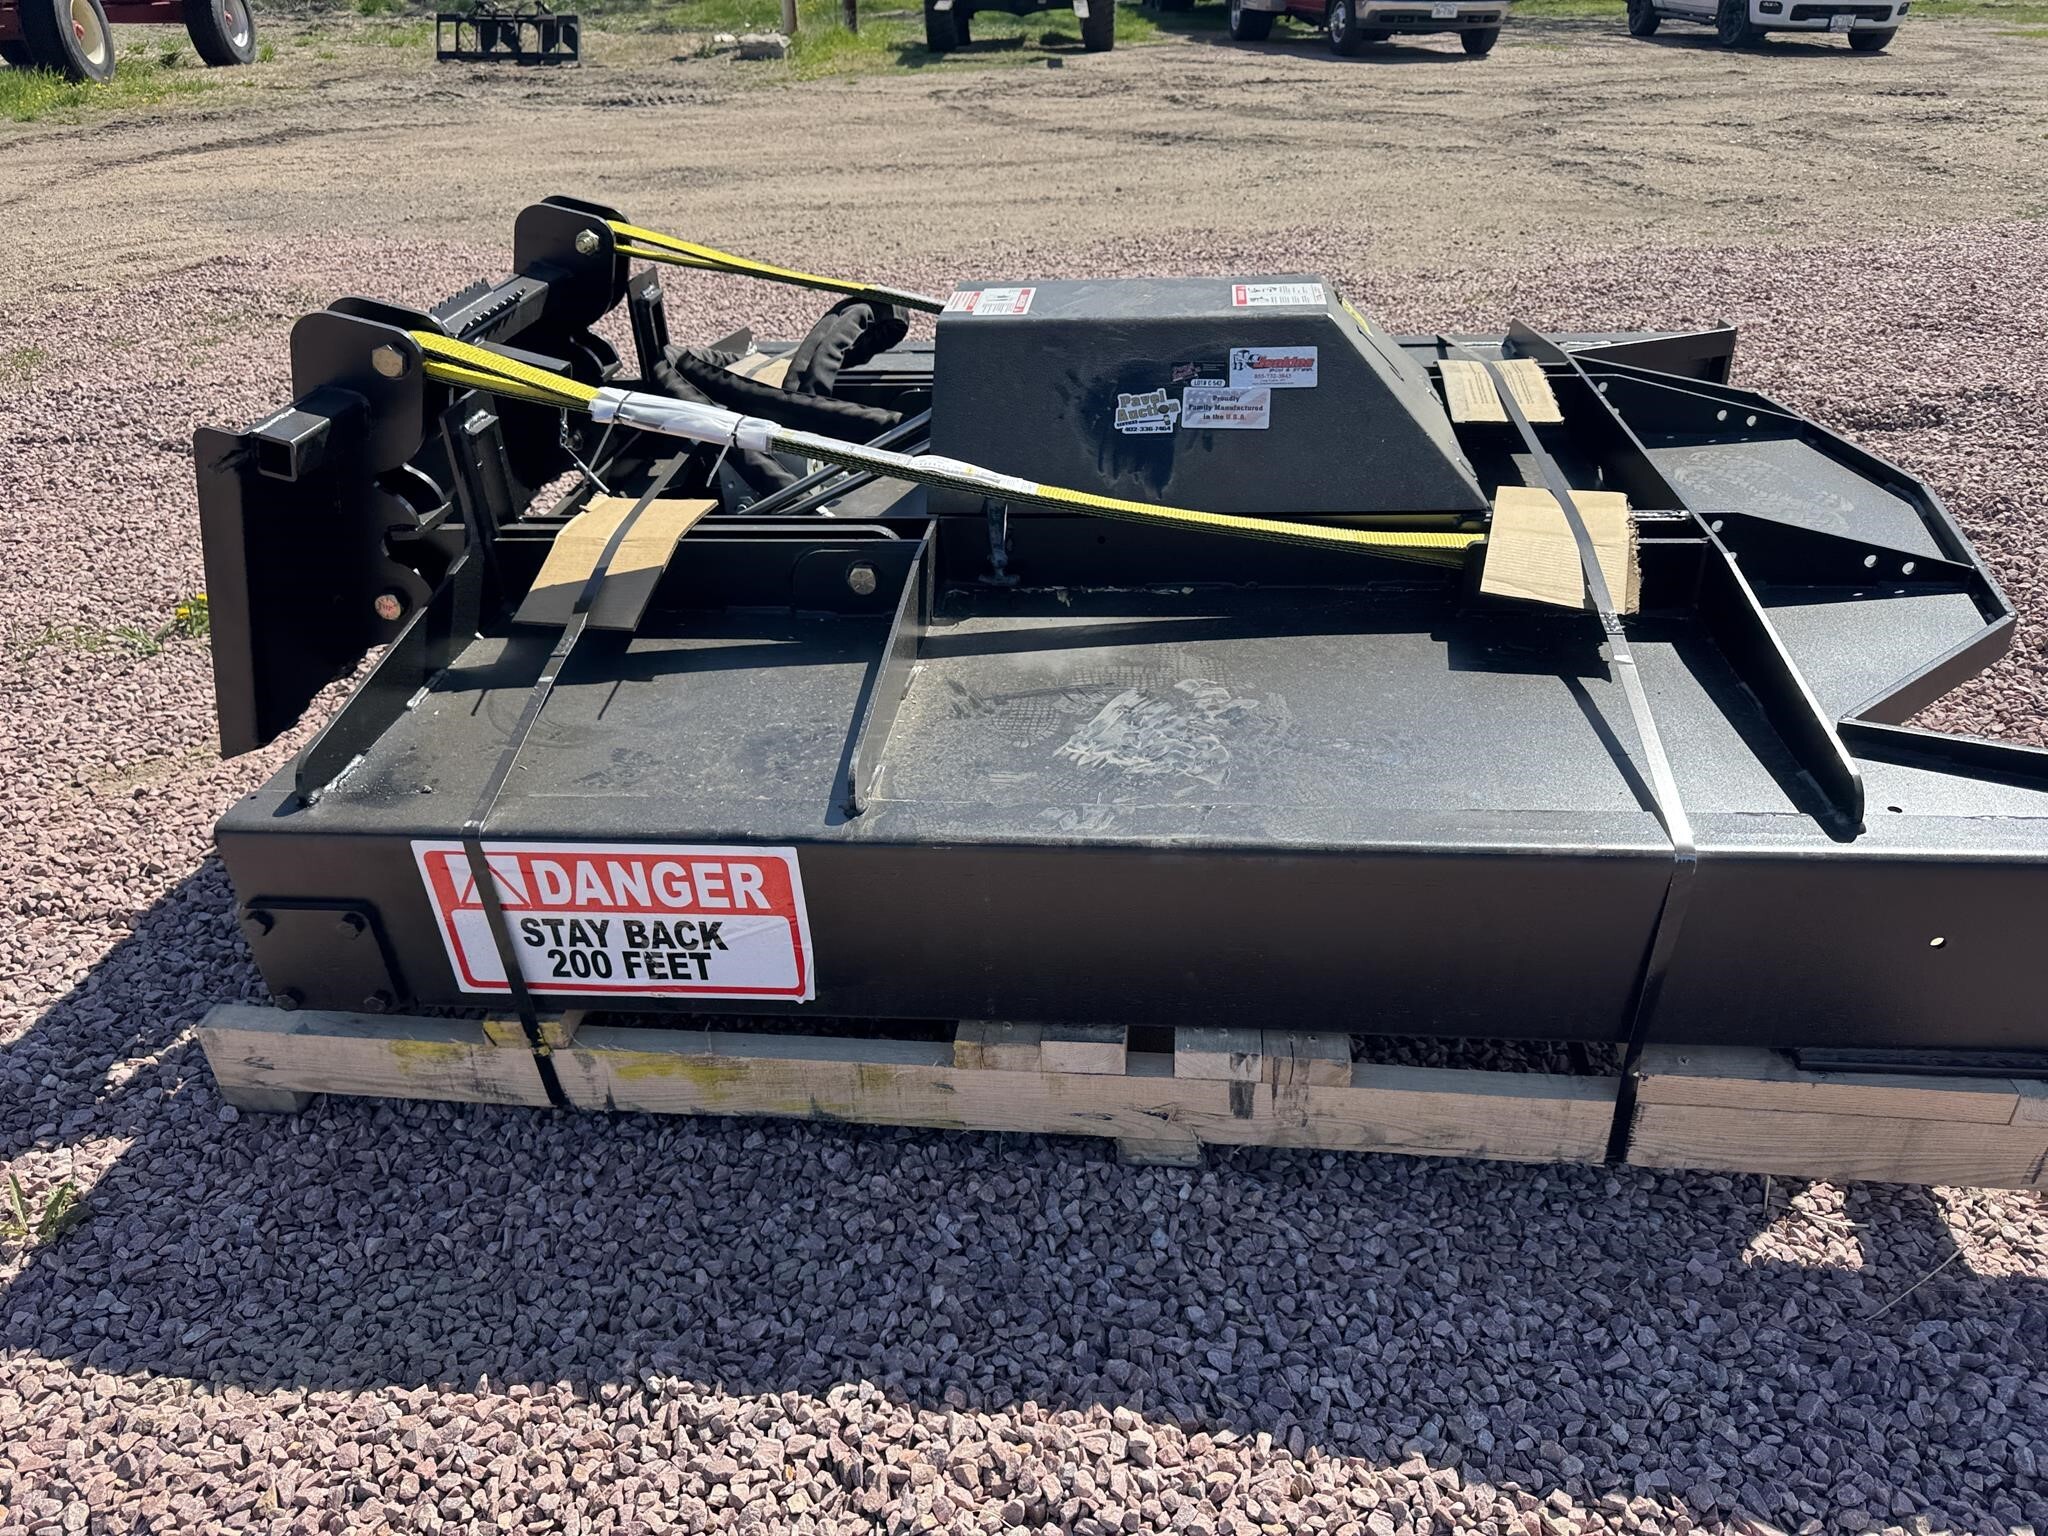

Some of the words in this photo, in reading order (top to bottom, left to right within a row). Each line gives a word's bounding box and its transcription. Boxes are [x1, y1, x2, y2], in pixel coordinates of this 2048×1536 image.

[1119, 390, 1166, 408] Pavel
[530, 859, 771, 910] DANGER
[519, 917, 610, 948] STAY
[623, 919, 729, 951] BACK
[547, 949, 613, 979] 200
[622, 951, 713, 981] FEET
